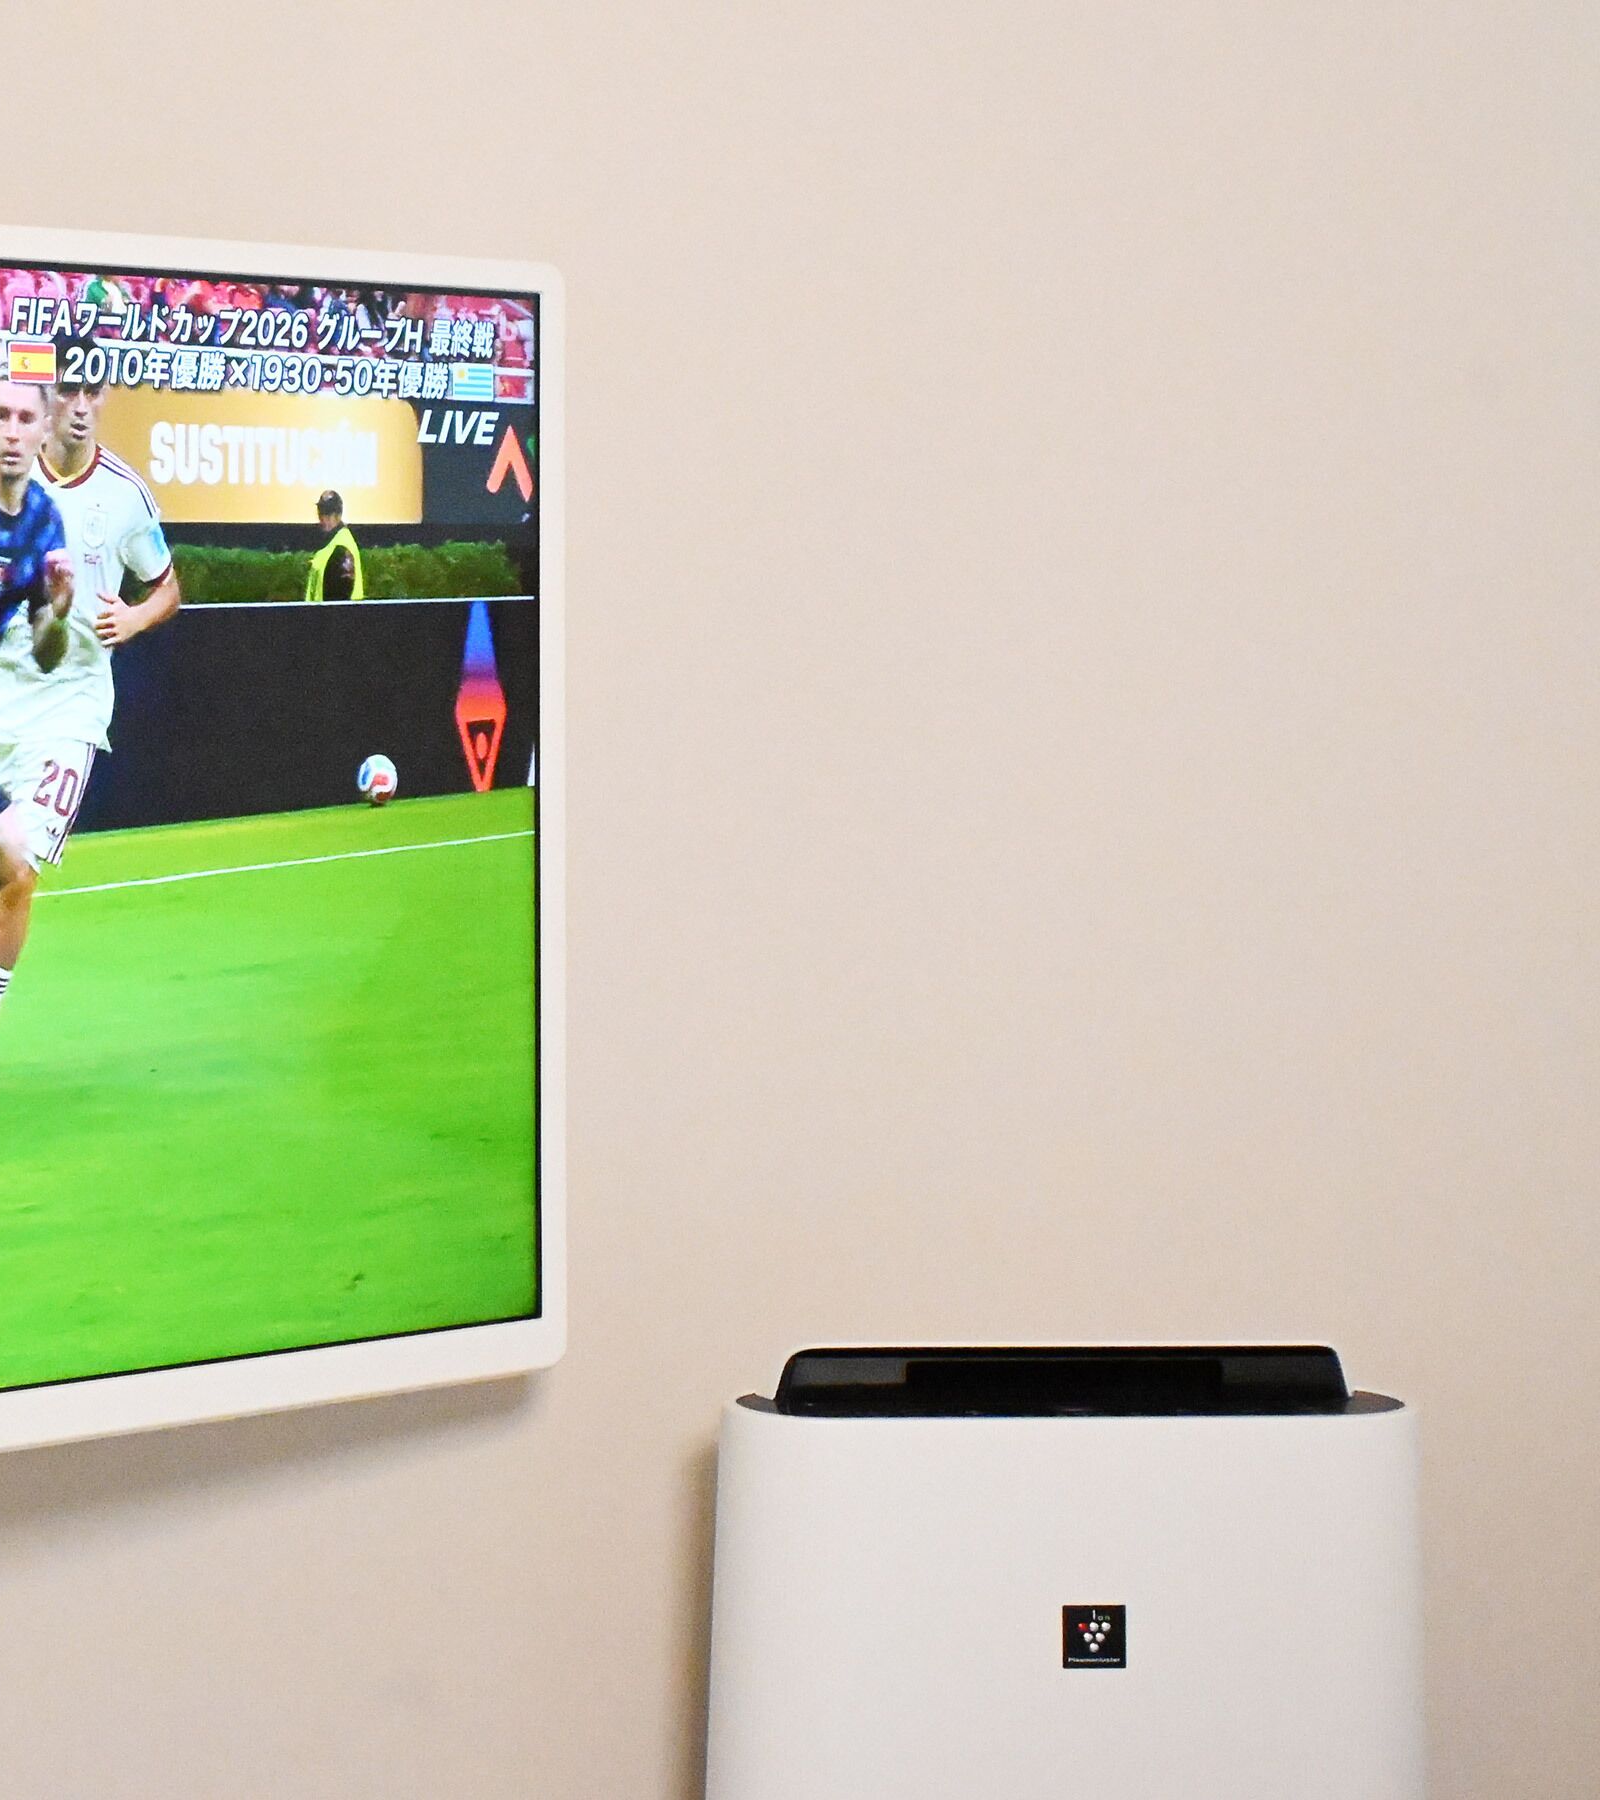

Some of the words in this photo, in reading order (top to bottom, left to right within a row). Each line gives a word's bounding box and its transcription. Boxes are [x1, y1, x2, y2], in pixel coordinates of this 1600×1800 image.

[10, 297, 310, 348] FIFAワールドカップ2026
[316, 312, 424, 353] グループH
[428, 319, 495, 359] 最終戦
[417, 409, 500, 445] LIVE
[32, 759, 79, 817] 20
[1092, 1609, 1111, 1621] Ion
